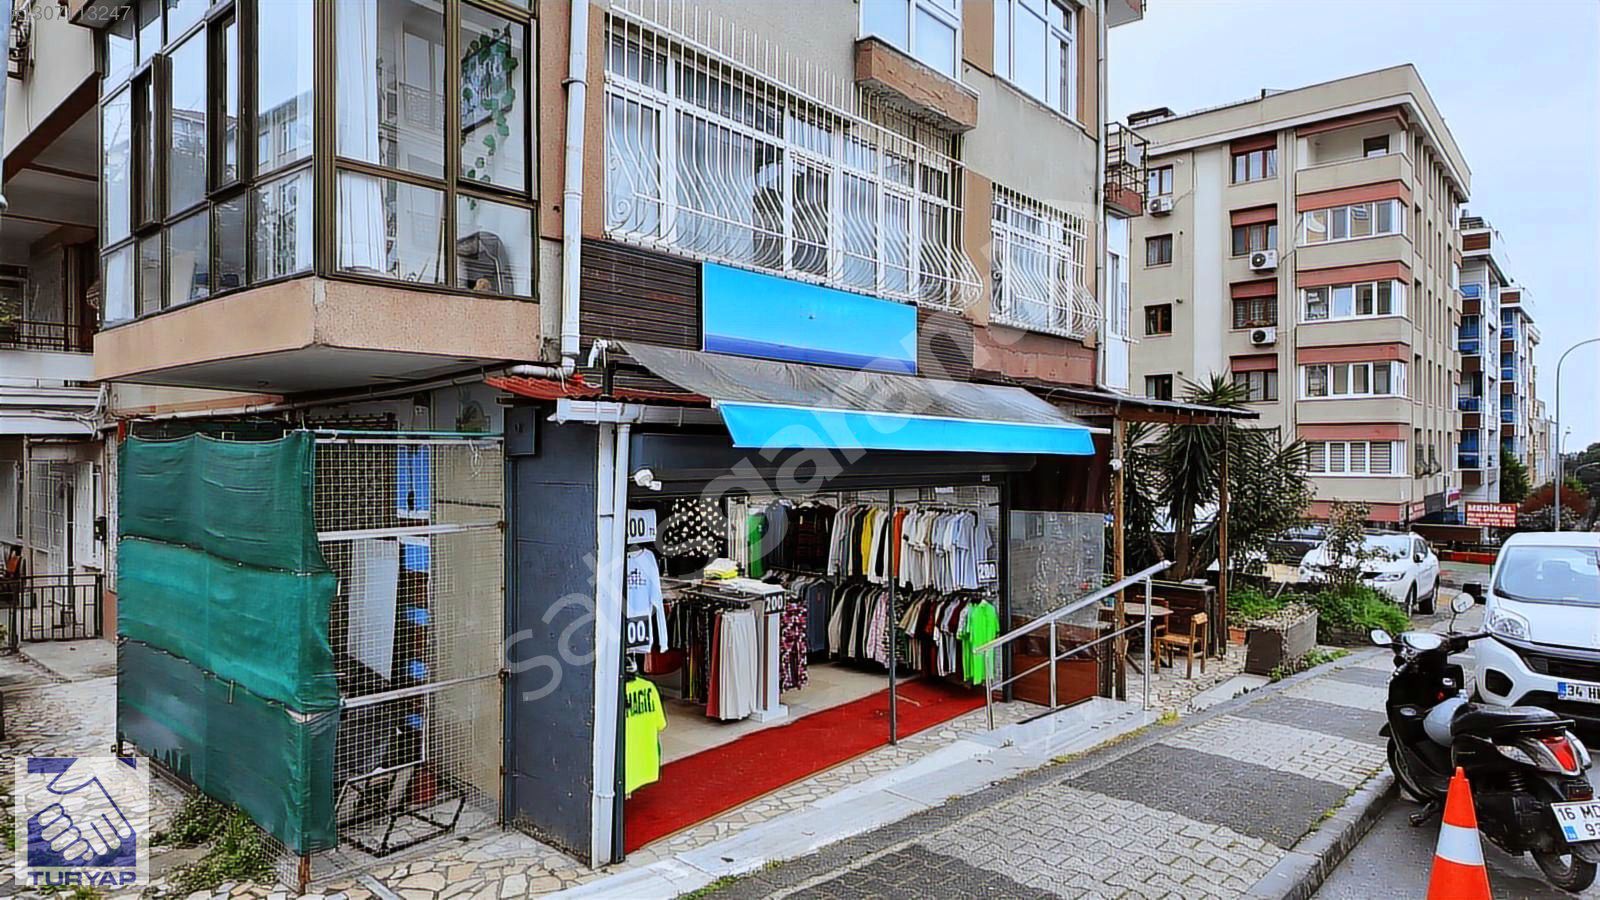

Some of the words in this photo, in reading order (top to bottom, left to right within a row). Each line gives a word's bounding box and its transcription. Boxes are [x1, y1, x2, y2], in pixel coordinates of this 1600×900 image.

[629, 517, 645, 538] 00
[765, 594, 783, 612] 200
[1568, 685, 1582, 697] 34
[1558, 807, 1576, 821] 16
